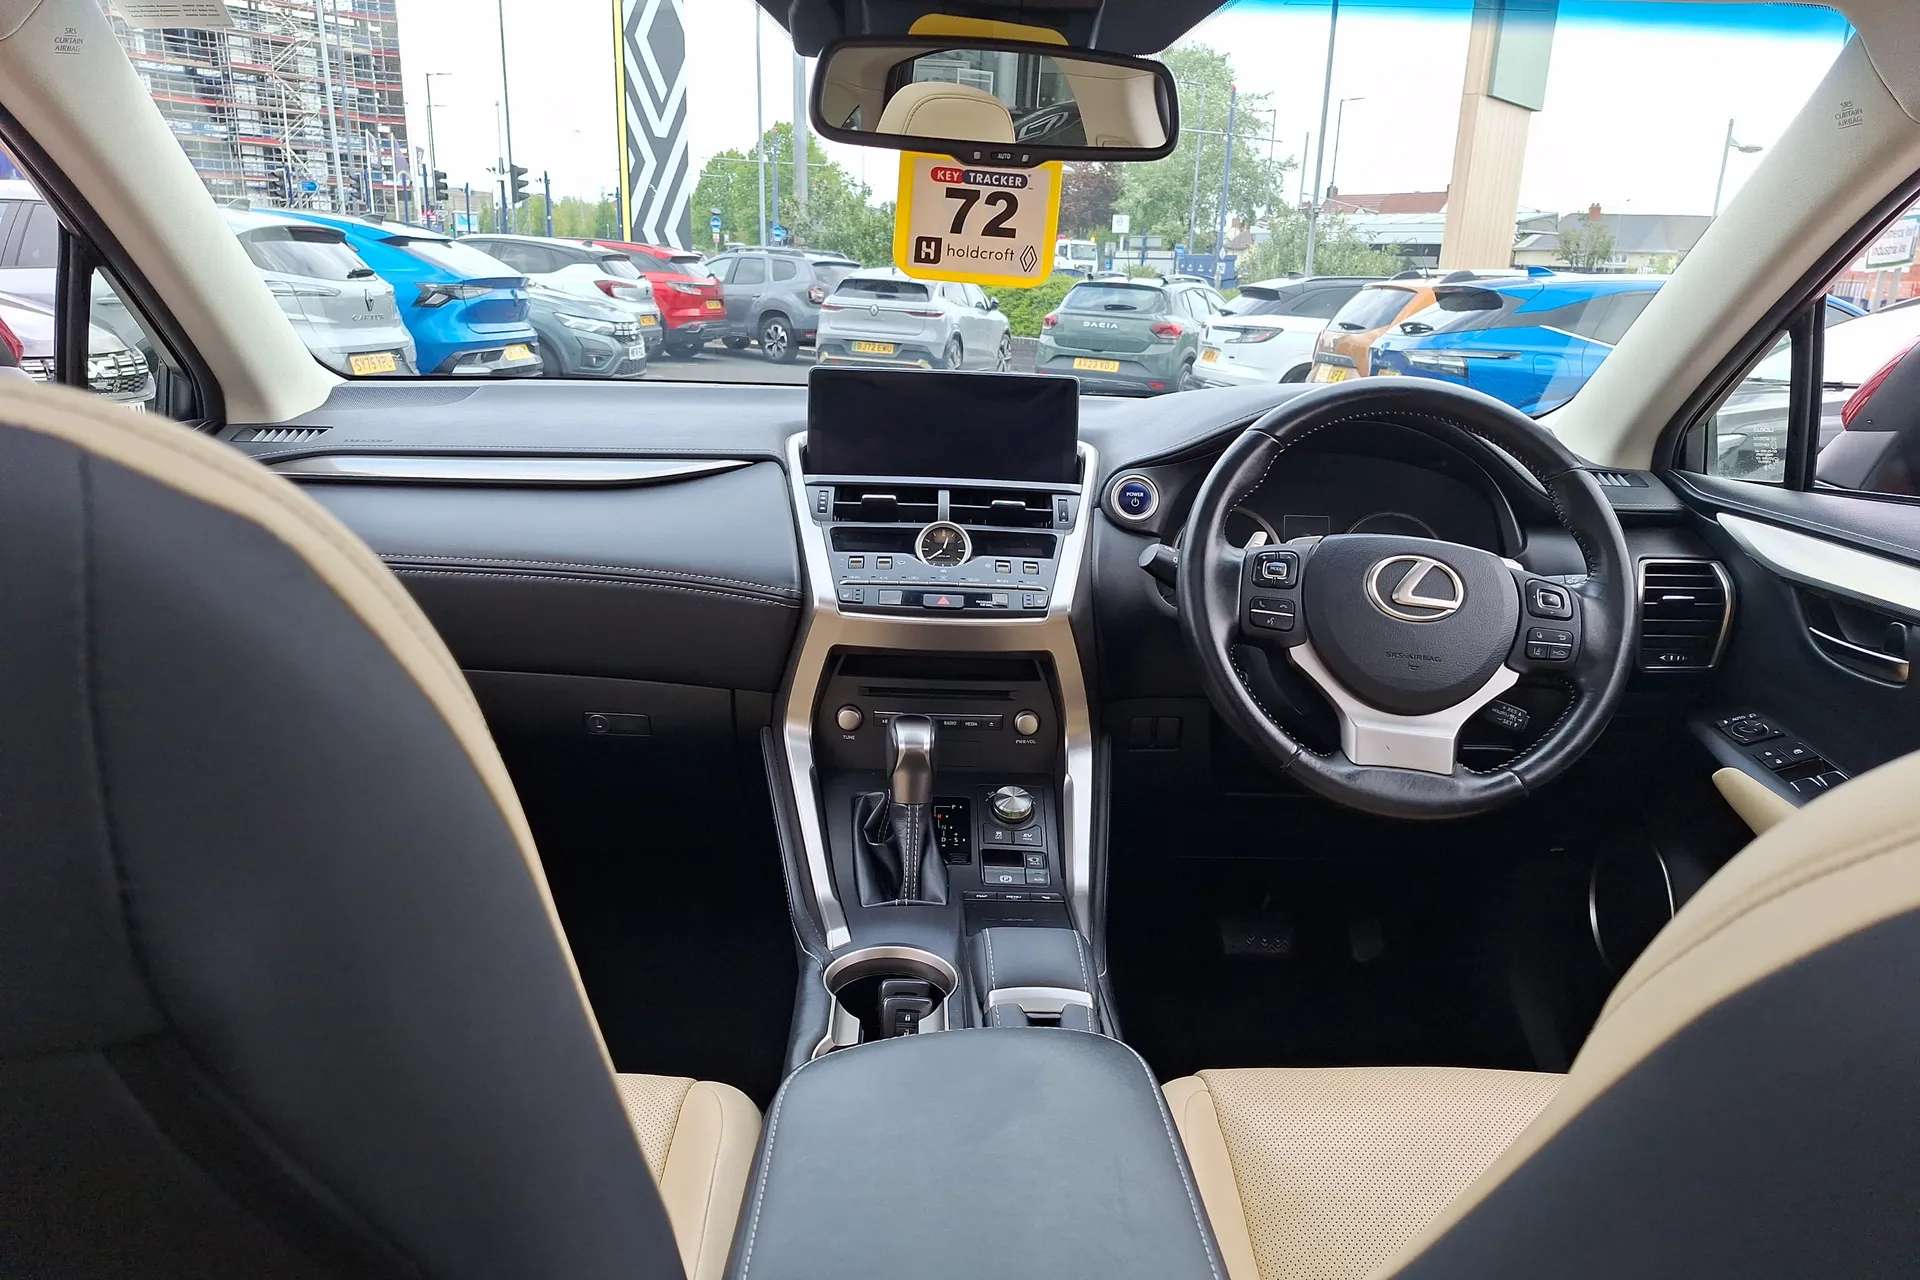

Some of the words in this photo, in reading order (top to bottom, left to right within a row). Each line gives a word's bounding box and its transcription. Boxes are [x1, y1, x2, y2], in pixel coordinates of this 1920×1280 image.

[936, 171, 960, 181] KEY
[968, 173, 1023, 187] TRACKER
[945, 187, 1019, 239] 72
[946, 243, 1015, 262] holdcroft
[1082, 320, 1119, 329] DACIA
